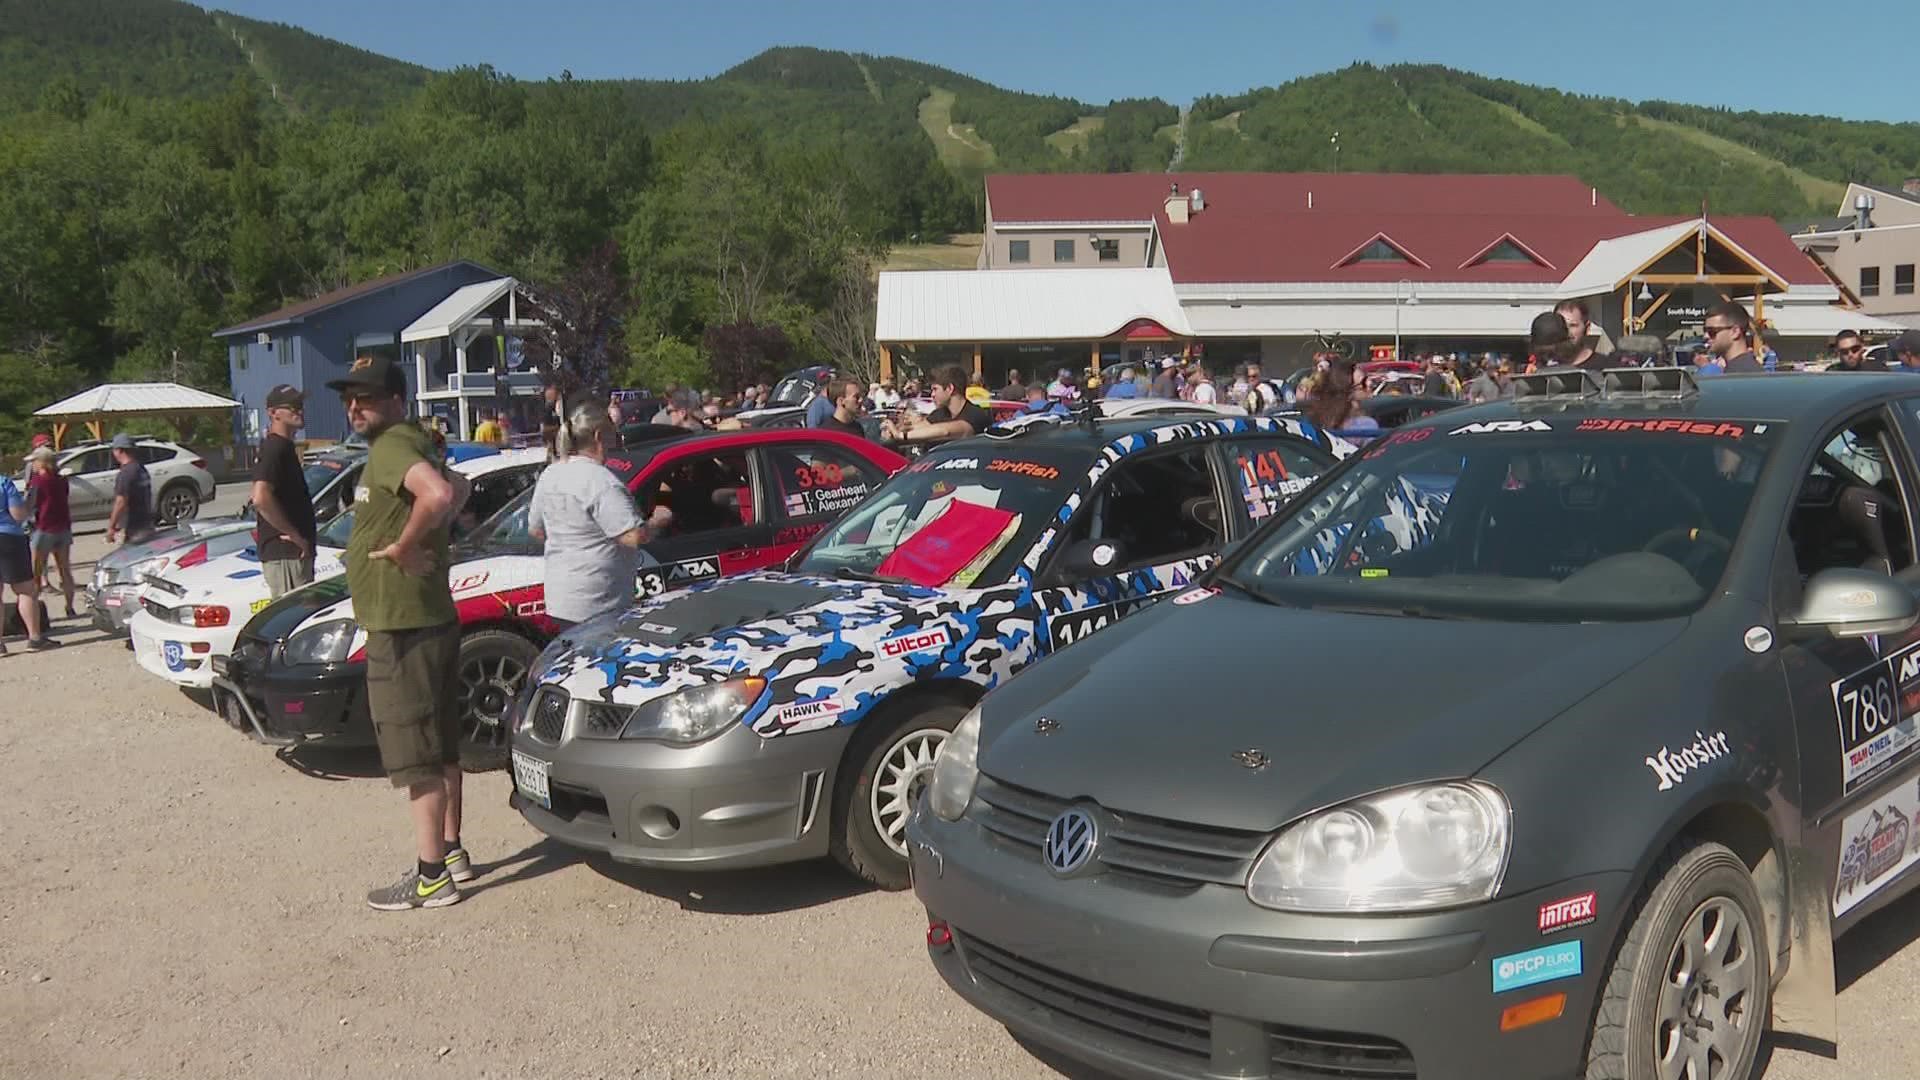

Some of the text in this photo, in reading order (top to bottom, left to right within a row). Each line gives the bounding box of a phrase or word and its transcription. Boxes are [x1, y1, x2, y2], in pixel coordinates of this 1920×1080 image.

[1449, 419, 1552, 435] ARA
[1577, 419, 1744, 438] DirtFish
[935, 459, 979, 470] ARA
[1237, 450, 1289, 487] 141
[667, 560, 716, 580] ARA
[882, 632, 945, 655] tilton
[782, 703, 822, 719] HAWK
[1843, 676, 1892, 742] 786
[1646, 730, 1730, 791] Hoosier
[1515, 952, 1575, 975] FCP EURO
